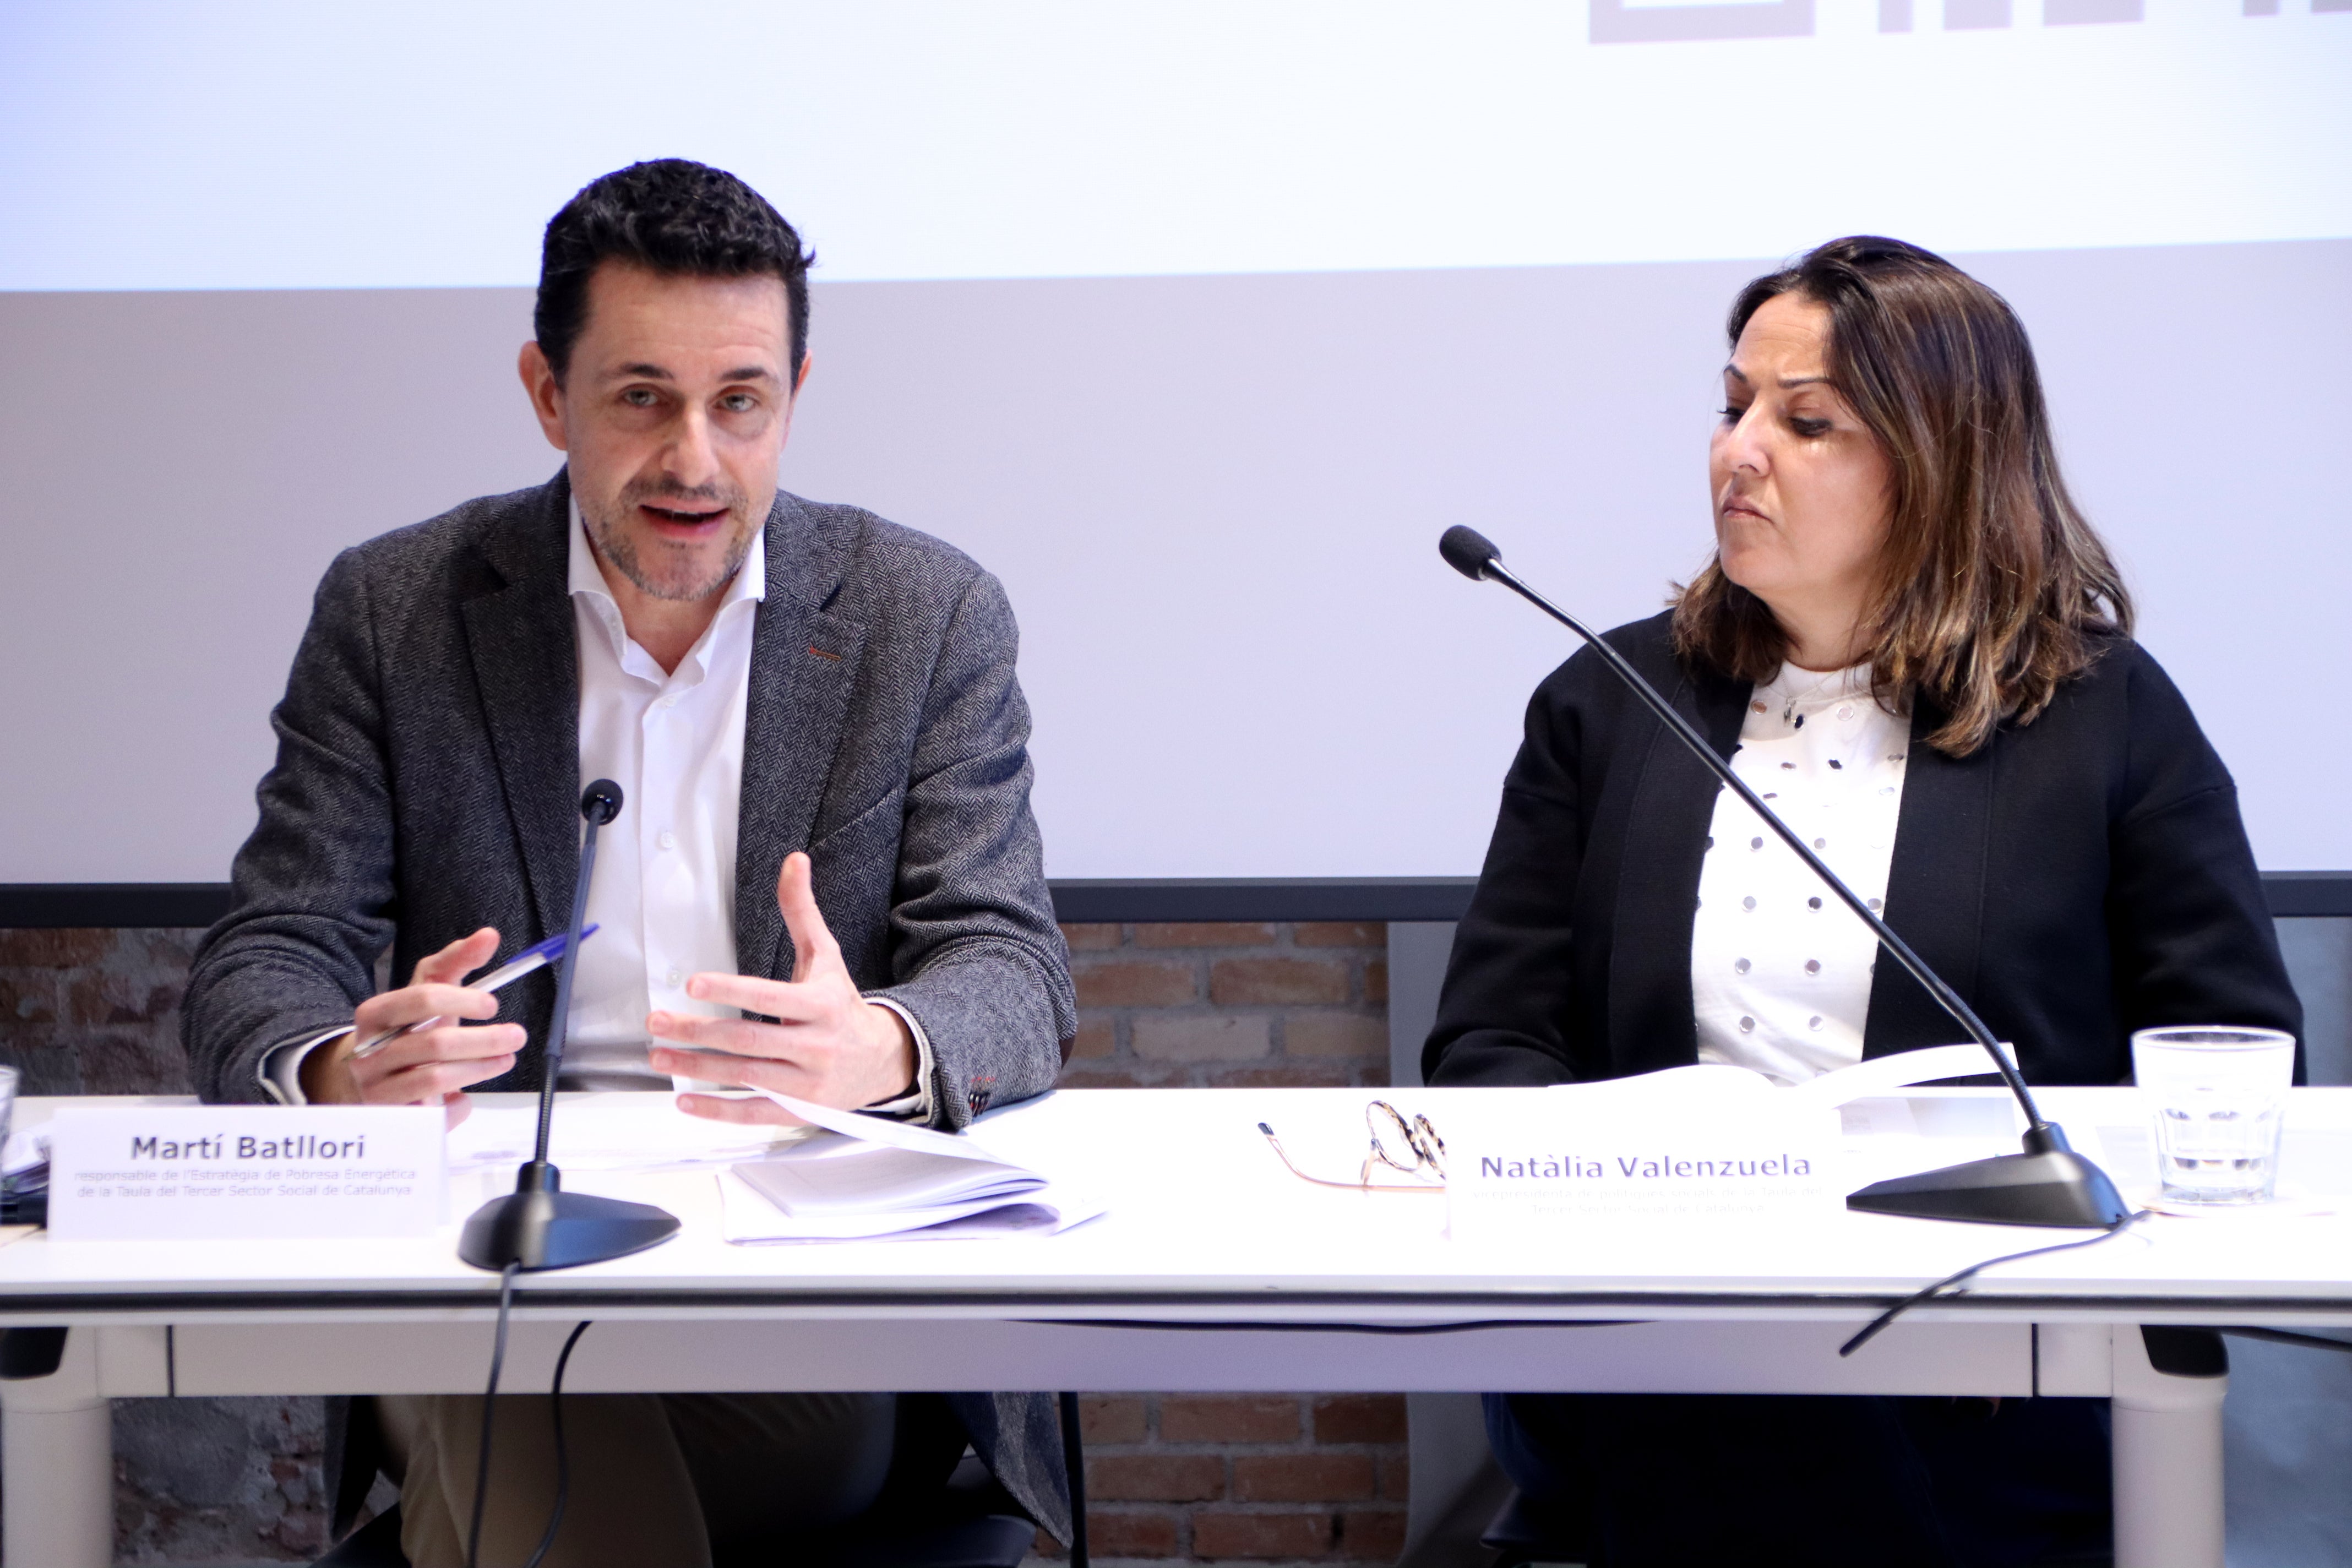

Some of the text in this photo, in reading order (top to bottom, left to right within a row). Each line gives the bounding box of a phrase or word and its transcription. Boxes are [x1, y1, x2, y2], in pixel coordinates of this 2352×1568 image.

[130, 1133, 365, 1159] Martí Batllori
[1481, 1153, 1812, 1178] Natàlia Valenzuela
[74, 1170, 155, 1183] responsable
[162, 1169, 178, 1180] de
[264, 1169, 281, 1180] de
[286, 1169, 339, 1180] Pobresa
[77, 1185, 410, 1197] de la Taula del Tercer Sector Social de Catalunya
